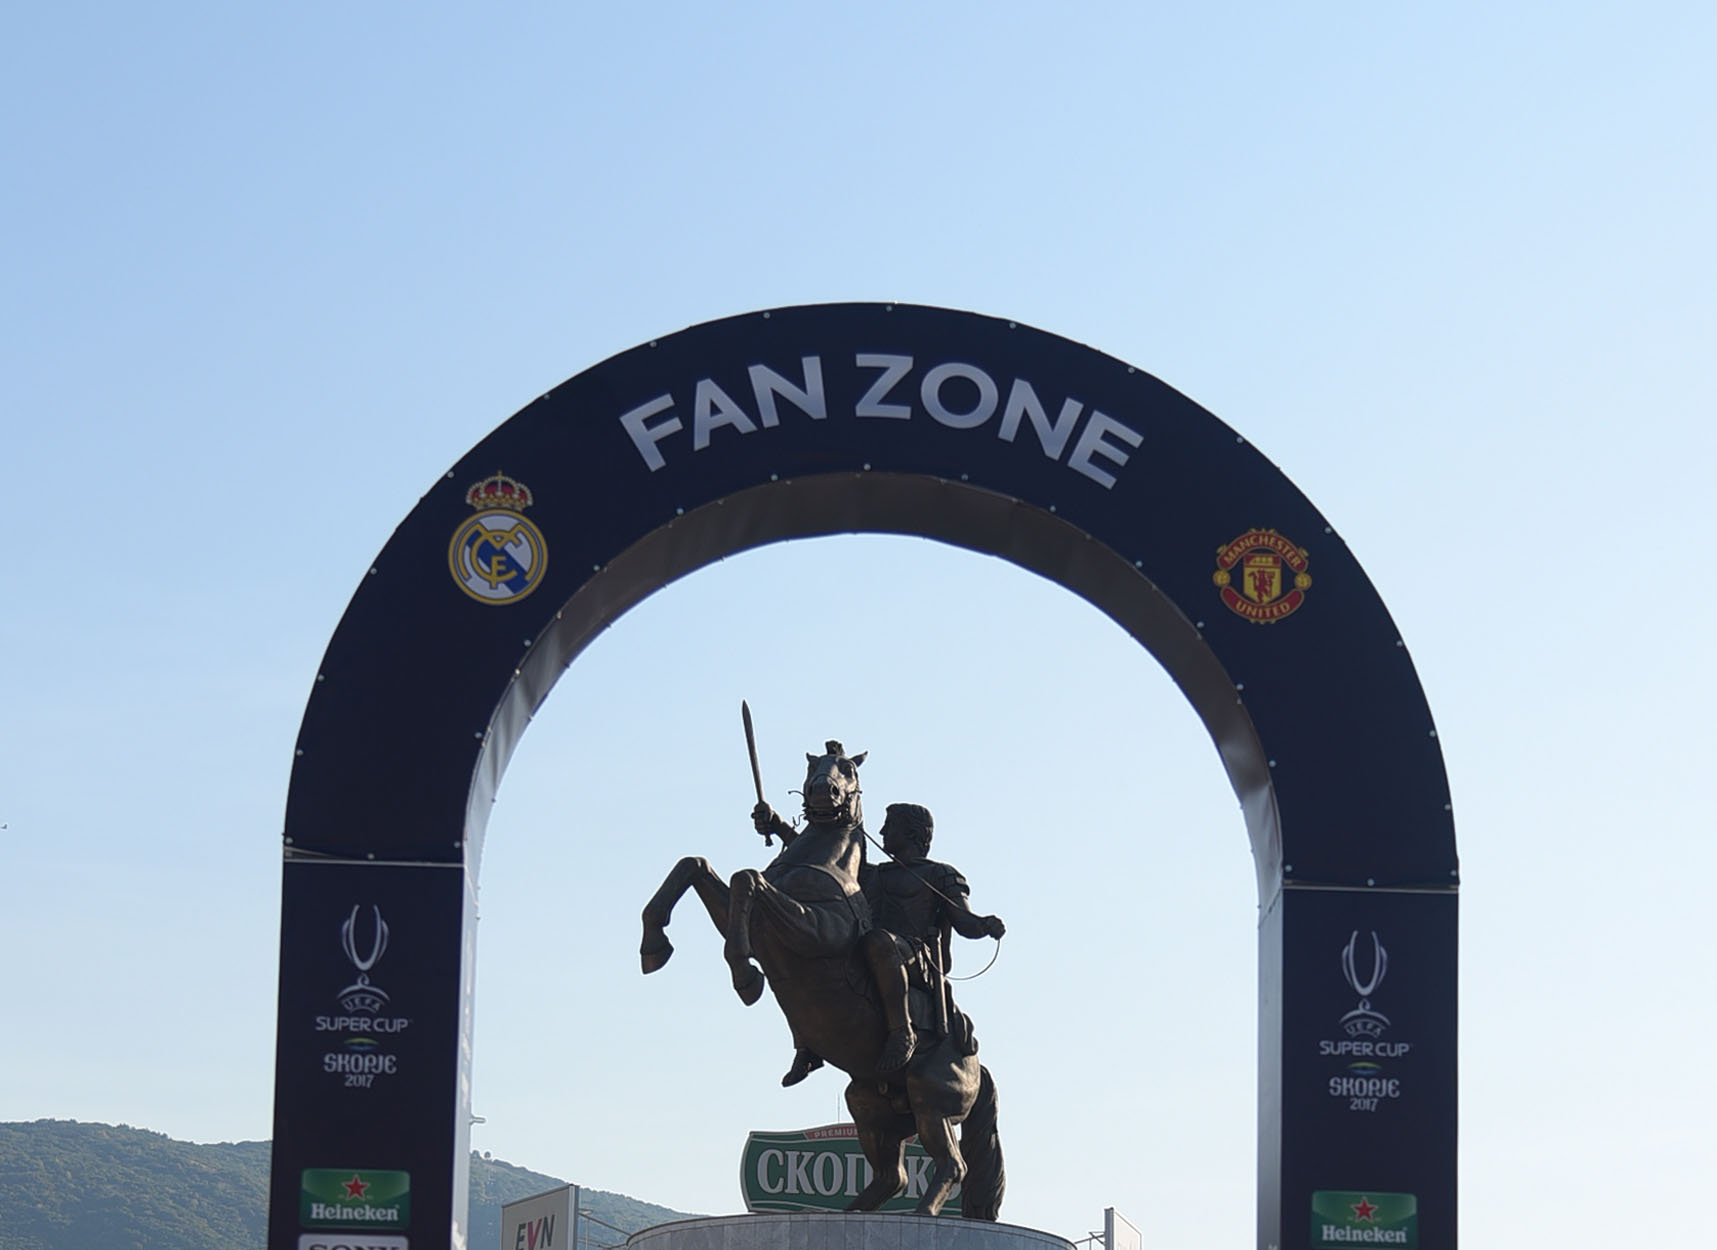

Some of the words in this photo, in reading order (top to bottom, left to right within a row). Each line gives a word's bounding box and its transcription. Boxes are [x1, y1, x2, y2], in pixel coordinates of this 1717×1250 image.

[619, 356, 827, 472] FAN
[855, 353, 1145, 489] ZONE
[1223, 535, 1301, 567] MANCHESTER
[1235, 601, 1291, 618] UNITED
[315, 1016, 371, 1031] SUPER
[373, 1018, 409, 1032] CUP
[1319, 1040, 1373, 1056] SUPER
[1375, 1042, 1410, 1057] CUP
[323, 1053, 398, 1074] SKOPJE
[344, 1074, 375, 1088] 2017
[1329, 1076, 1401, 1098] SKOPJE
[1349, 1098, 1379, 1113] 2017
[310, 1203, 399, 1221] Heineken
[1321, 1224, 1408, 1243] Heineken
